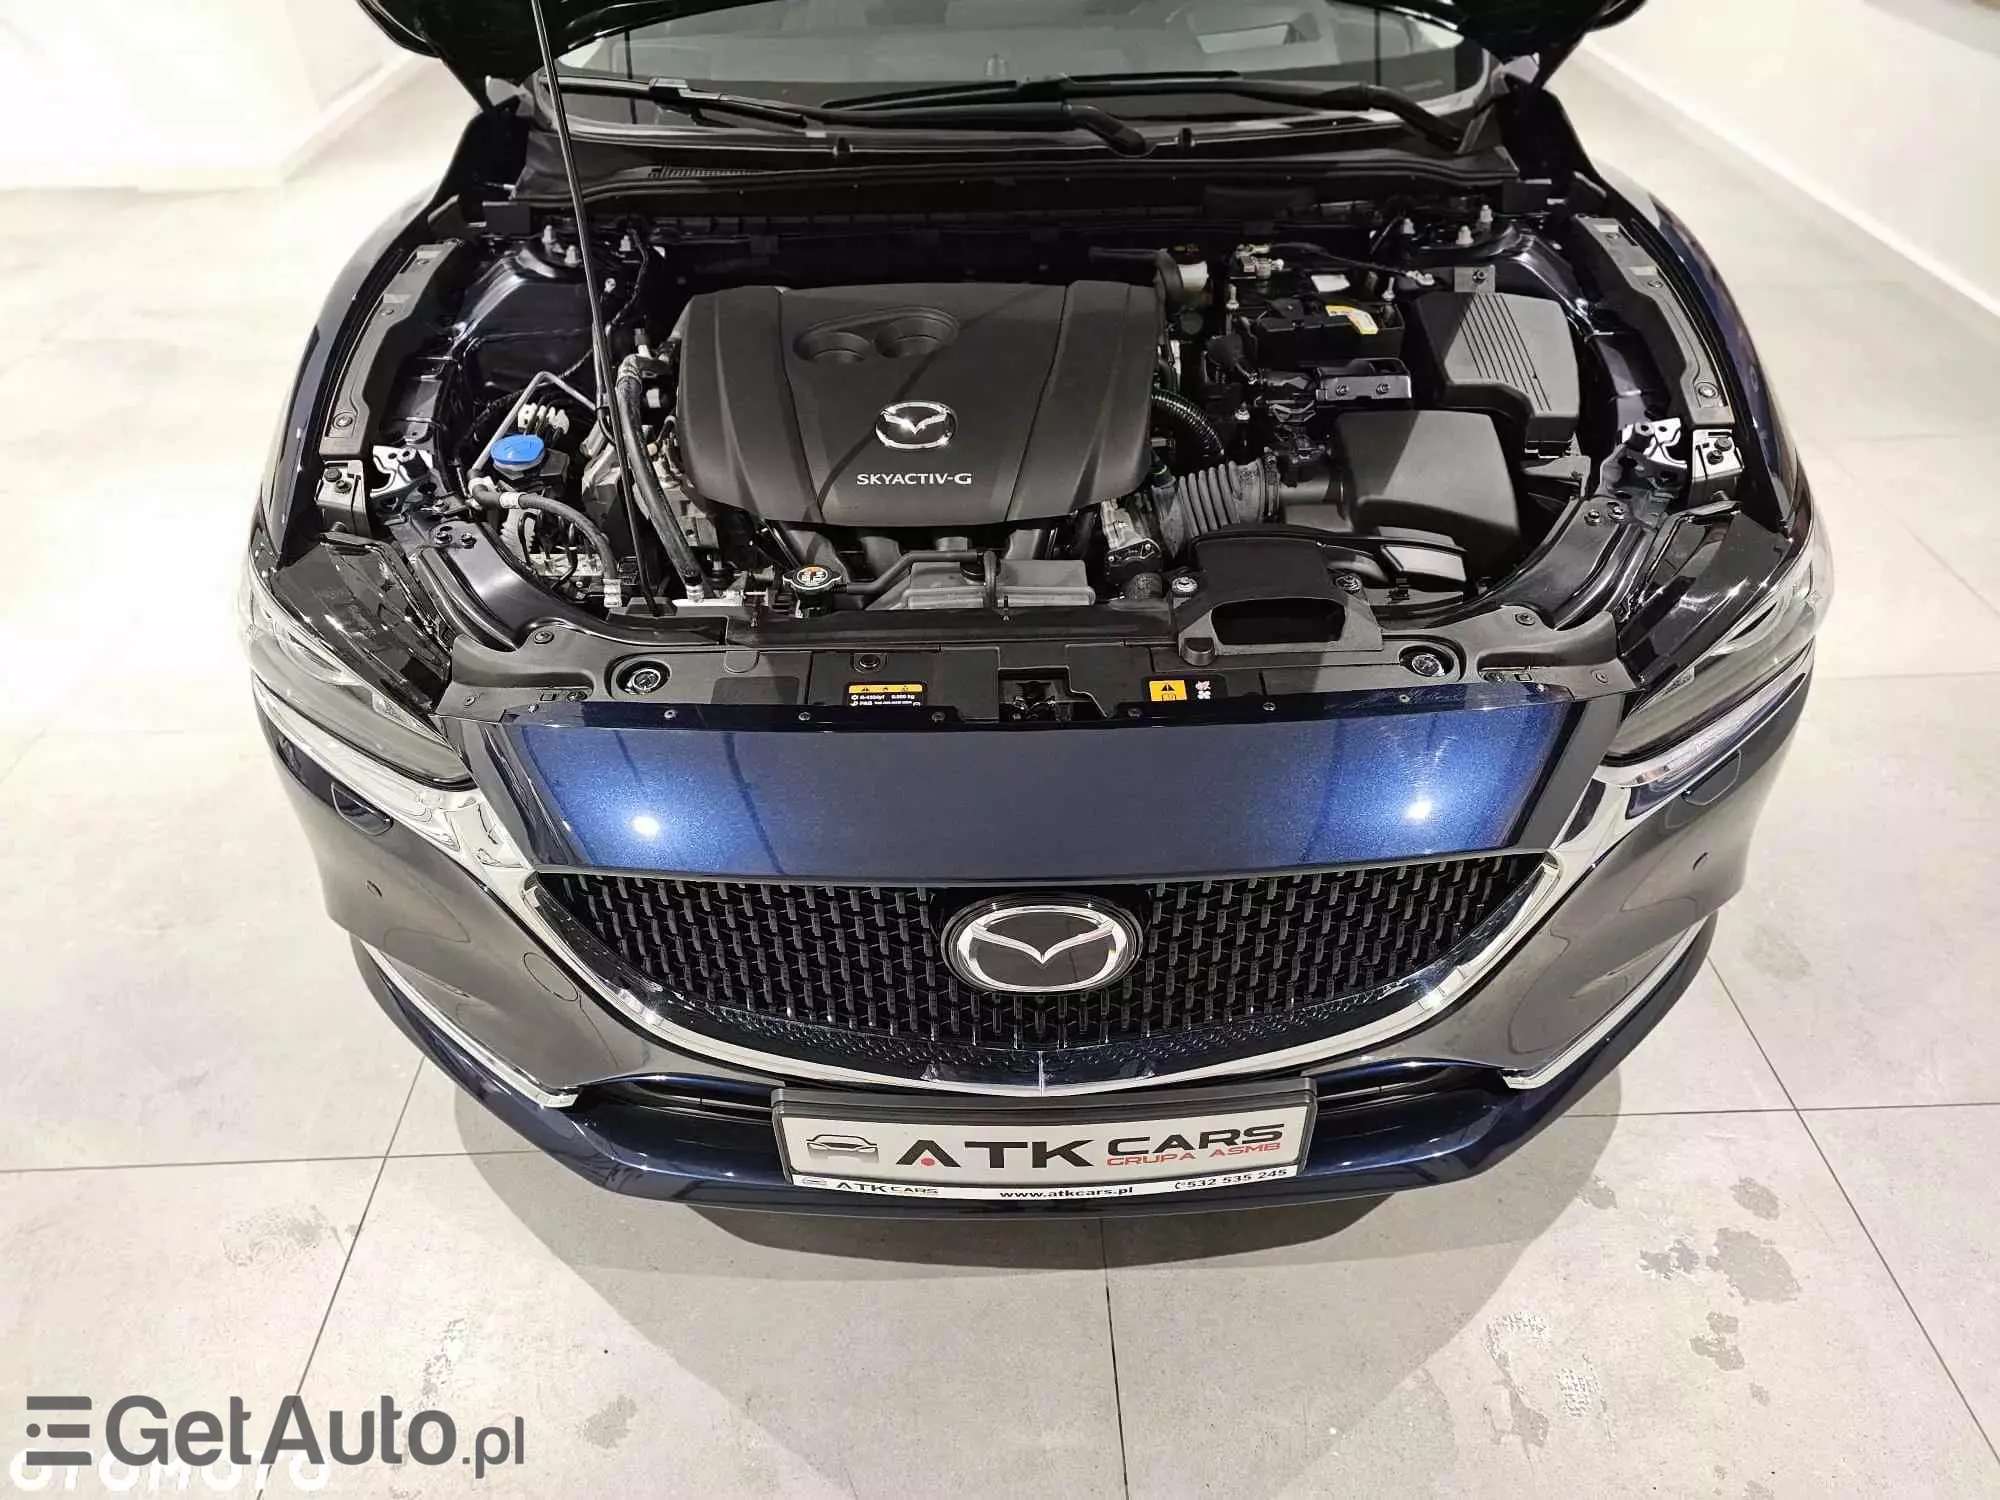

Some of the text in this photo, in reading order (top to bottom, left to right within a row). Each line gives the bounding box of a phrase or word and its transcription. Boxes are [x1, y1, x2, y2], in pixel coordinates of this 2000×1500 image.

[856, 472, 972, 486] SKYACTIV-G
[896, 1123, 1285, 1169] ATK CARS
[1107, 1142, 1281, 1167] GRUPA ASMB
[836, 1181, 887, 1193] ATK
[890, 1186, 939, 1195] CARS
[999, 1186, 1133, 1198] www.atkcars.pl
[1223, 1173, 1252, 1184] 535
[1258, 1168, 1288, 1180] 245
